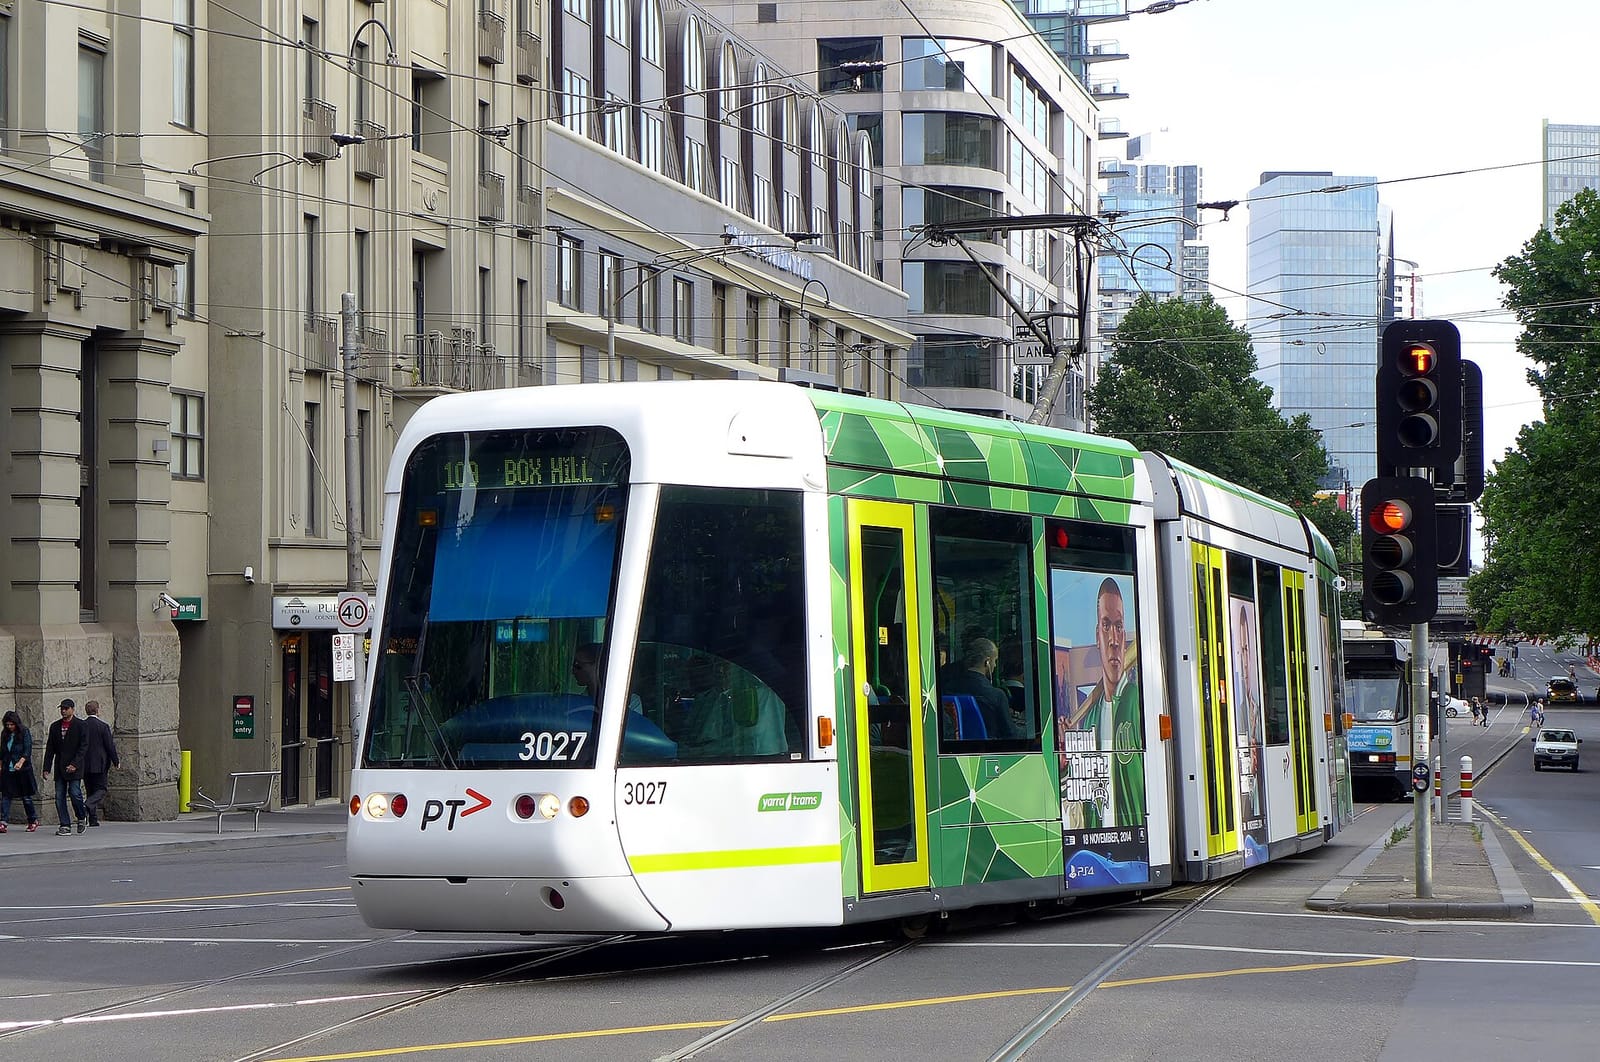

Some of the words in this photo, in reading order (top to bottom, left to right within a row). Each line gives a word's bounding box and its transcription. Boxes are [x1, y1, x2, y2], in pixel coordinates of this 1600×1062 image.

[1018, 346, 1051, 357] LAN
[1411, 349, 1431, 370] T
[504, 458, 542, 486] BOX
[185, 604, 197, 614] entry
[342, 605, 364, 620] 40
[518, 731, 588, 761] 3027
[624, 781, 667, 805] 3027
[762, 798, 785, 810] yarra
[793, 796, 817, 806] trams
[1090, 832, 1119, 844] NOVEMBER,
[1120, 830, 1132, 842] 2014
[1077, 866, 1094, 877] PS4
